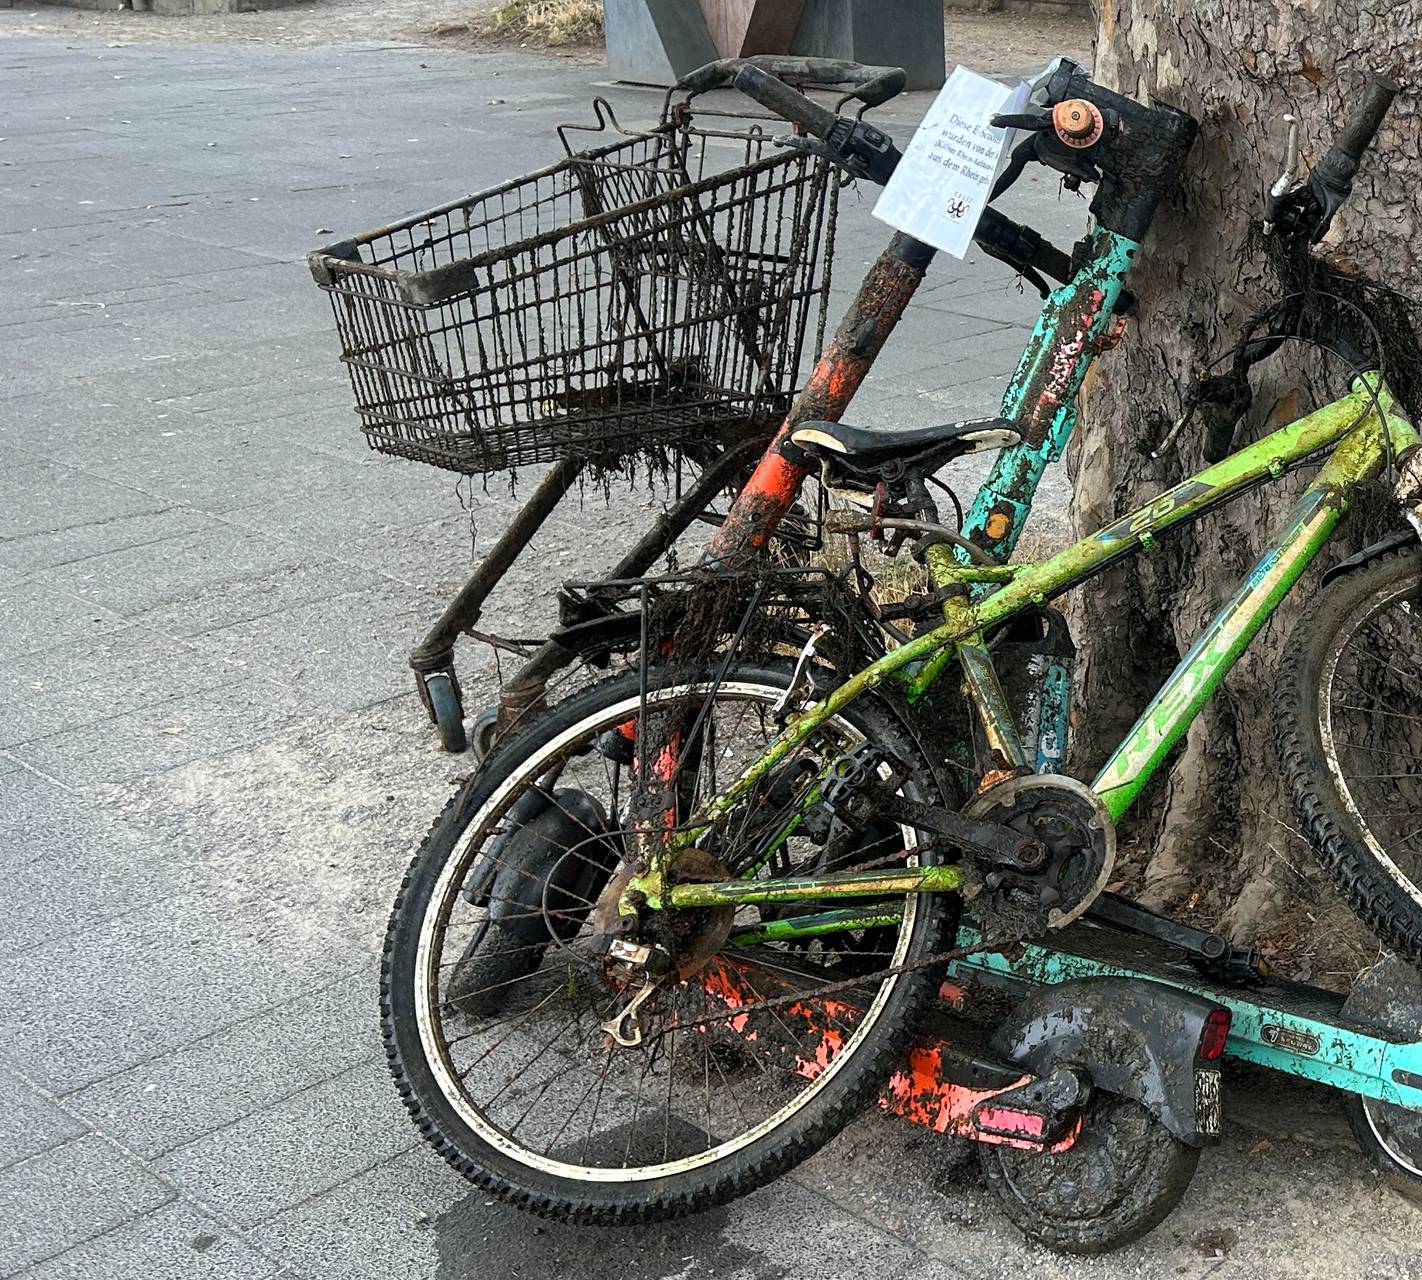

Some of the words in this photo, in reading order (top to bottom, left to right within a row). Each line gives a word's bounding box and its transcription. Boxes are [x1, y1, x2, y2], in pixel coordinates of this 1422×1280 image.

[949, 113, 972, 131] Diese
[942, 129, 972, 149] wurden
[972, 143, 985, 155] von
[985, 147, 996, 159] der
[928, 151, 941, 164] aus
[942, 158, 960, 172] dem
[960, 165, 980, 181] Rhein
